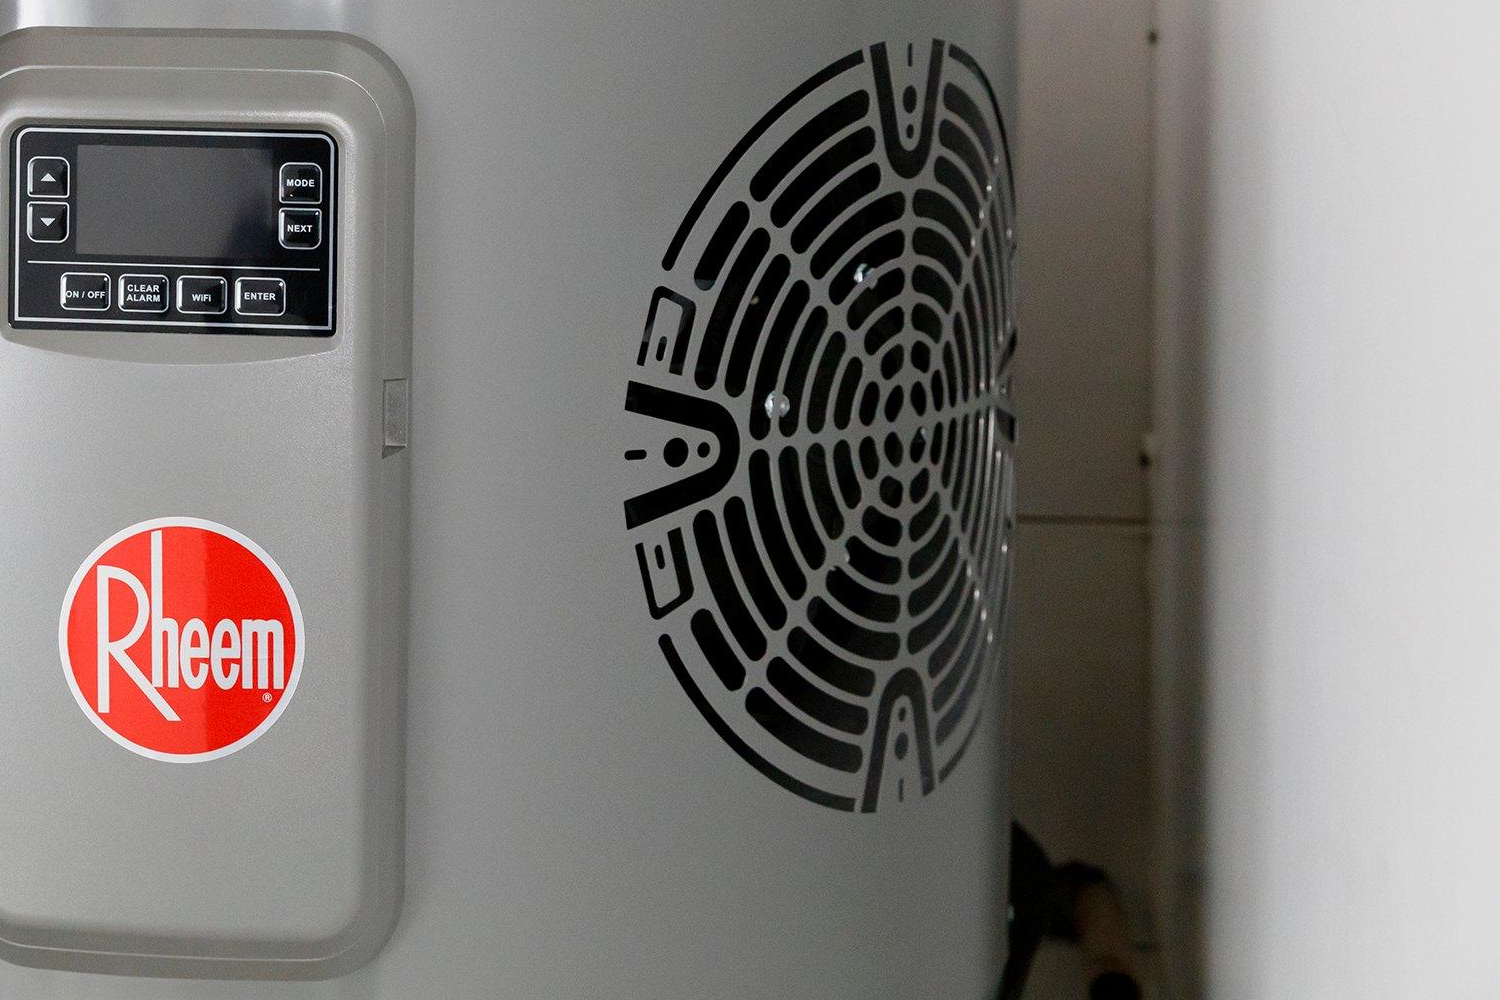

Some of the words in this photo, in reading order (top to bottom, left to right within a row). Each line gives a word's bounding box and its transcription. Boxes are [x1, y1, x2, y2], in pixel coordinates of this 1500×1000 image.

[286, 179, 315, 187] MODE
[287, 224, 312, 233] NEXT
[127, 283, 160, 293] CLEAR
[65, 290, 79, 299] ON
[87, 291, 106, 300] OFF
[126, 293, 161, 303] ALARM
[244, 292, 276, 301] ENTER
